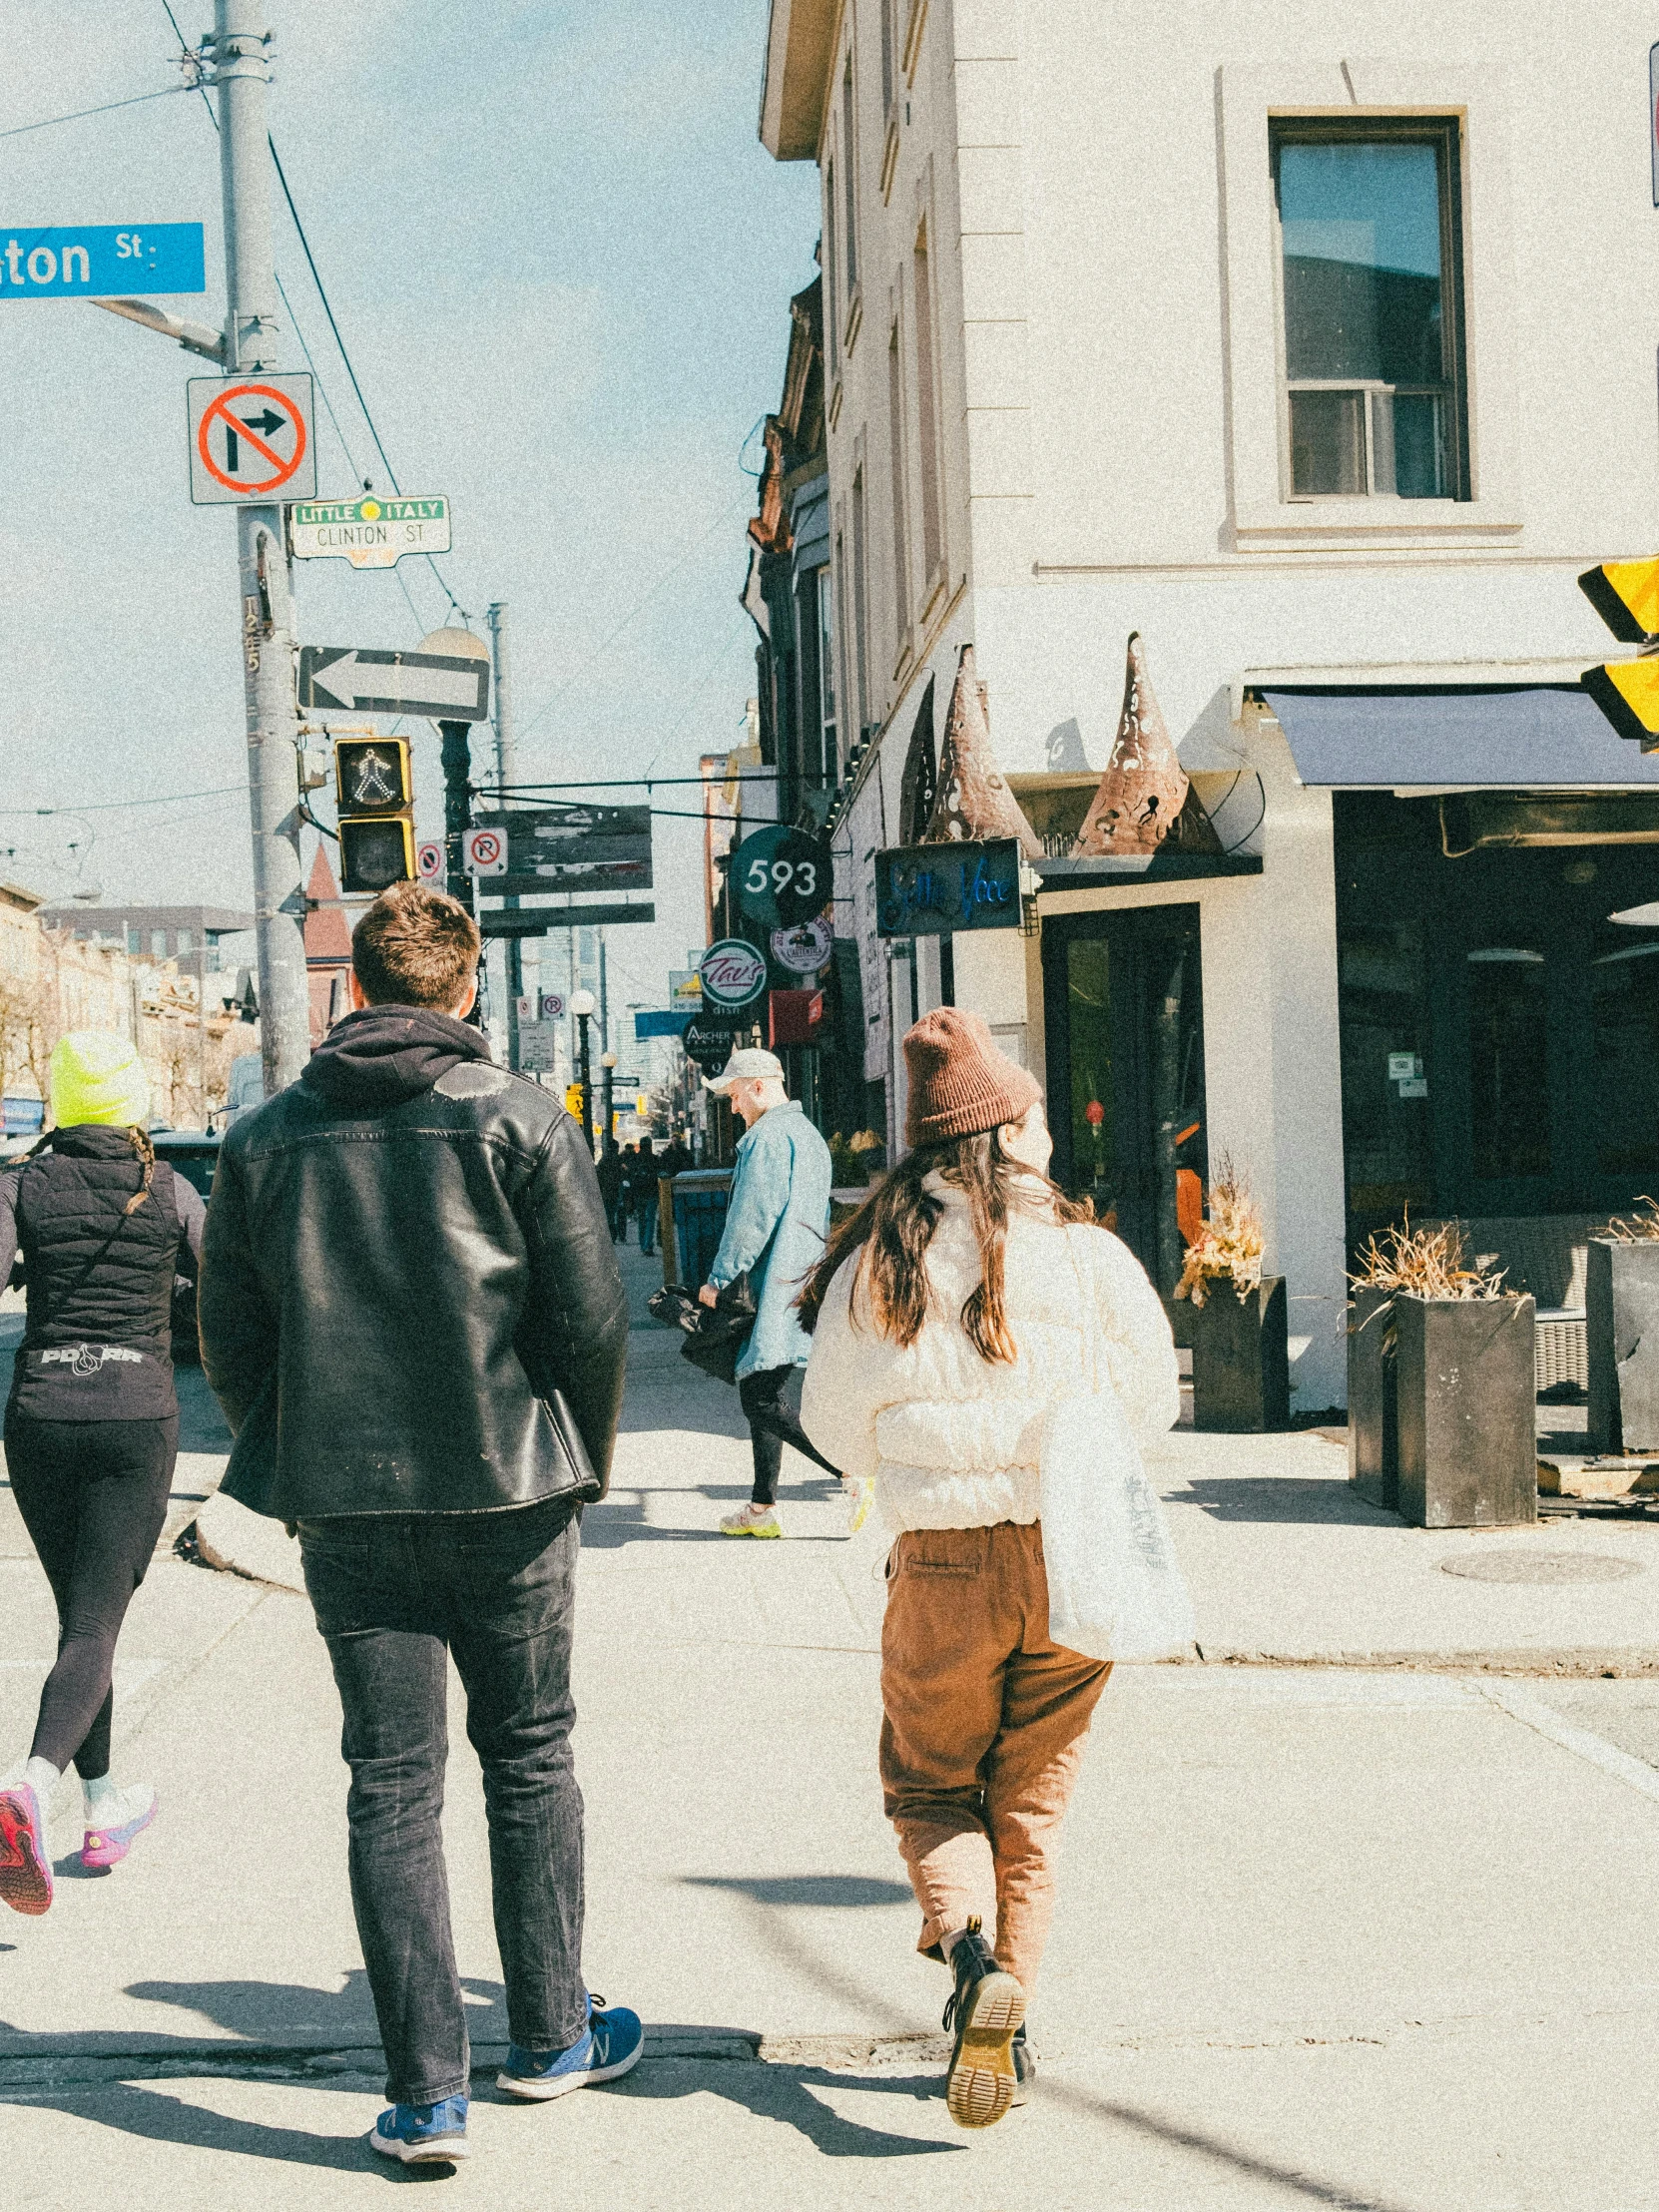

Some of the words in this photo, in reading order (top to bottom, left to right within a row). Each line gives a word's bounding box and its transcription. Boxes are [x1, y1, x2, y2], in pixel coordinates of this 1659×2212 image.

[0, 239, 91, 284] ton
[115, 233, 143, 259] St
[300, 506, 355, 523] LITTLE
[386, 502, 439, 519] ITALY
[316, 526, 387, 546] CLINTON
[405, 524, 424, 542] ST
[744, 859, 817, 896] 593
[700, 956, 766, 984] Tav's
